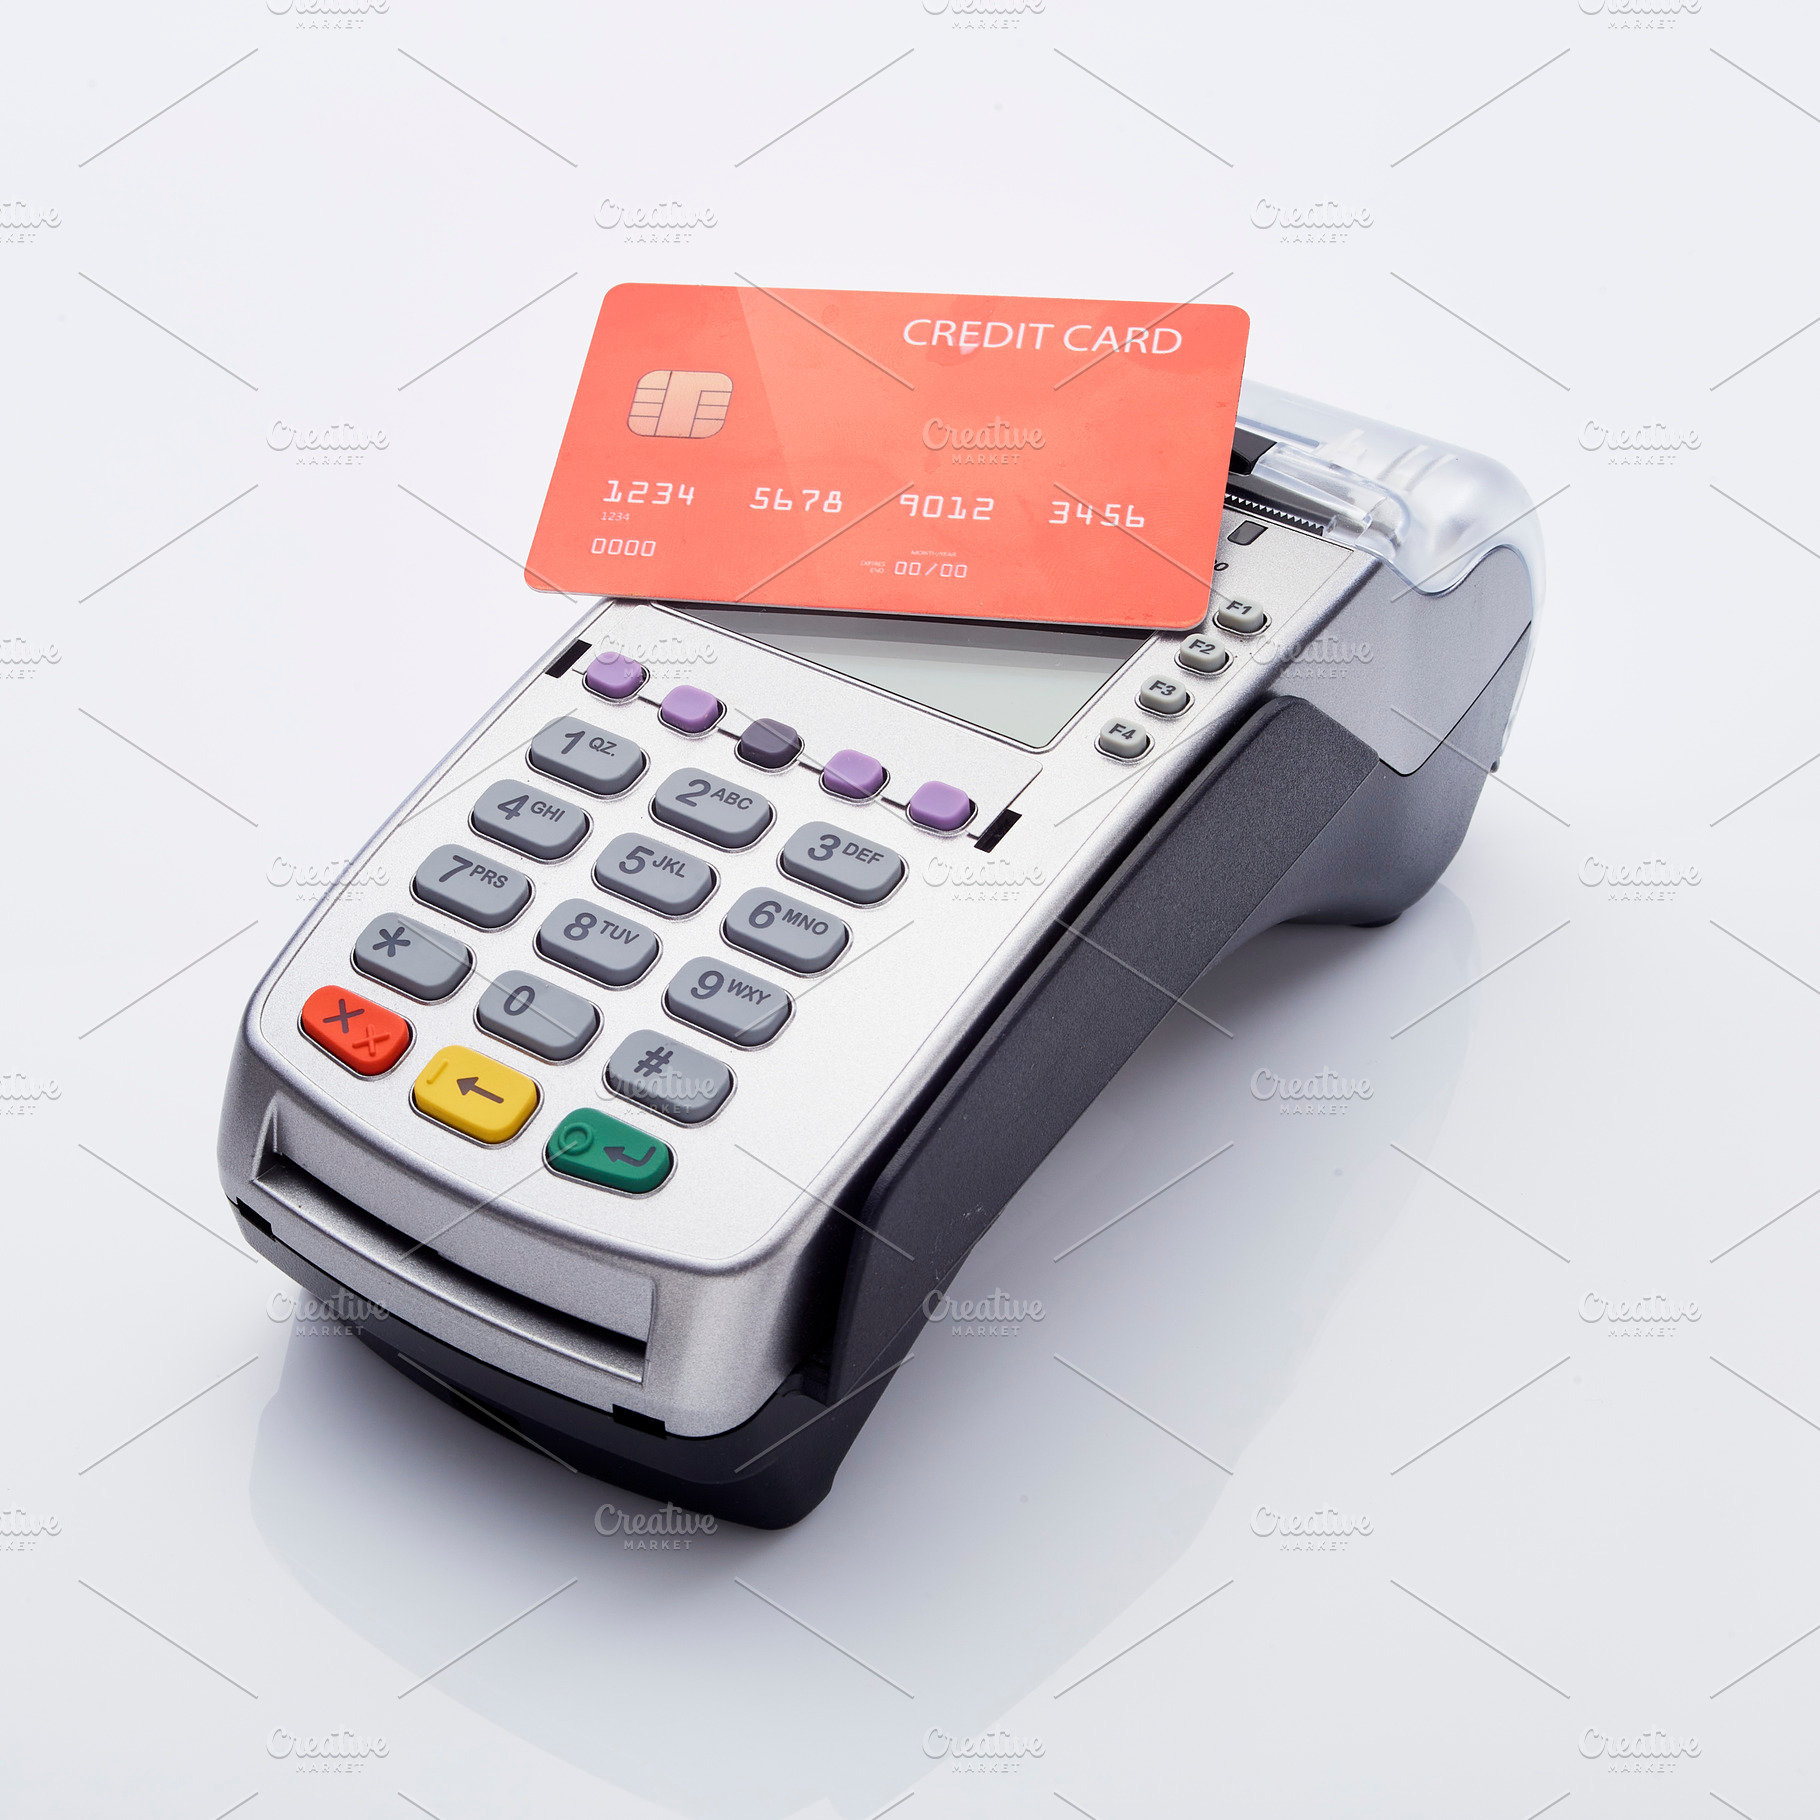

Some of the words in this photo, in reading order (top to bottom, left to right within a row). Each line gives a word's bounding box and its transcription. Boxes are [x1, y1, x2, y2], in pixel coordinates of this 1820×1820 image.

[903, 319, 1055, 350] CREDIT
[1063, 324, 1184, 354] CARD
[600, 511, 630, 522] 1234
[602, 480, 695, 506] 1234
[750, 487, 843, 513] 5678
[899, 494, 995, 520] 9012
[1048, 501, 1145, 528] 3456
[591, 537, 656, 557] 0000
[894, 561, 968, 578] 00/00
[1226, 600, 1253, 615] F1
[1188, 638, 1216, 655] F2
[1149, 680, 1177, 696] F3
[560, 730, 586, 755] 1
[1108, 723, 1136, 740] F4
[497, 794, 530, 821] 4
[530, 801, 565, 823] GHI
[675, 779, 711, 808] 2
[710, 787, 754, 811] ABC
[619, 845, 655, 875] 5
[652, 855, 686, 878] JKL
[807, 834, 841, 862] 3
[842, 842, 884, 866] DEF
[438, 854, 473, 883] 7
[469, 865, 509, 889] PRS
[563, 912, 598, 941] 8
[599, 920, 640, 945] TUV
[748, 900, 783, 929] 6
[782, 907, 829, 936] MNO
[502, 985, 537, 1016] 0
[690, 970, 724, 1000] 9
[727, 978, 772, 1005] WXY
